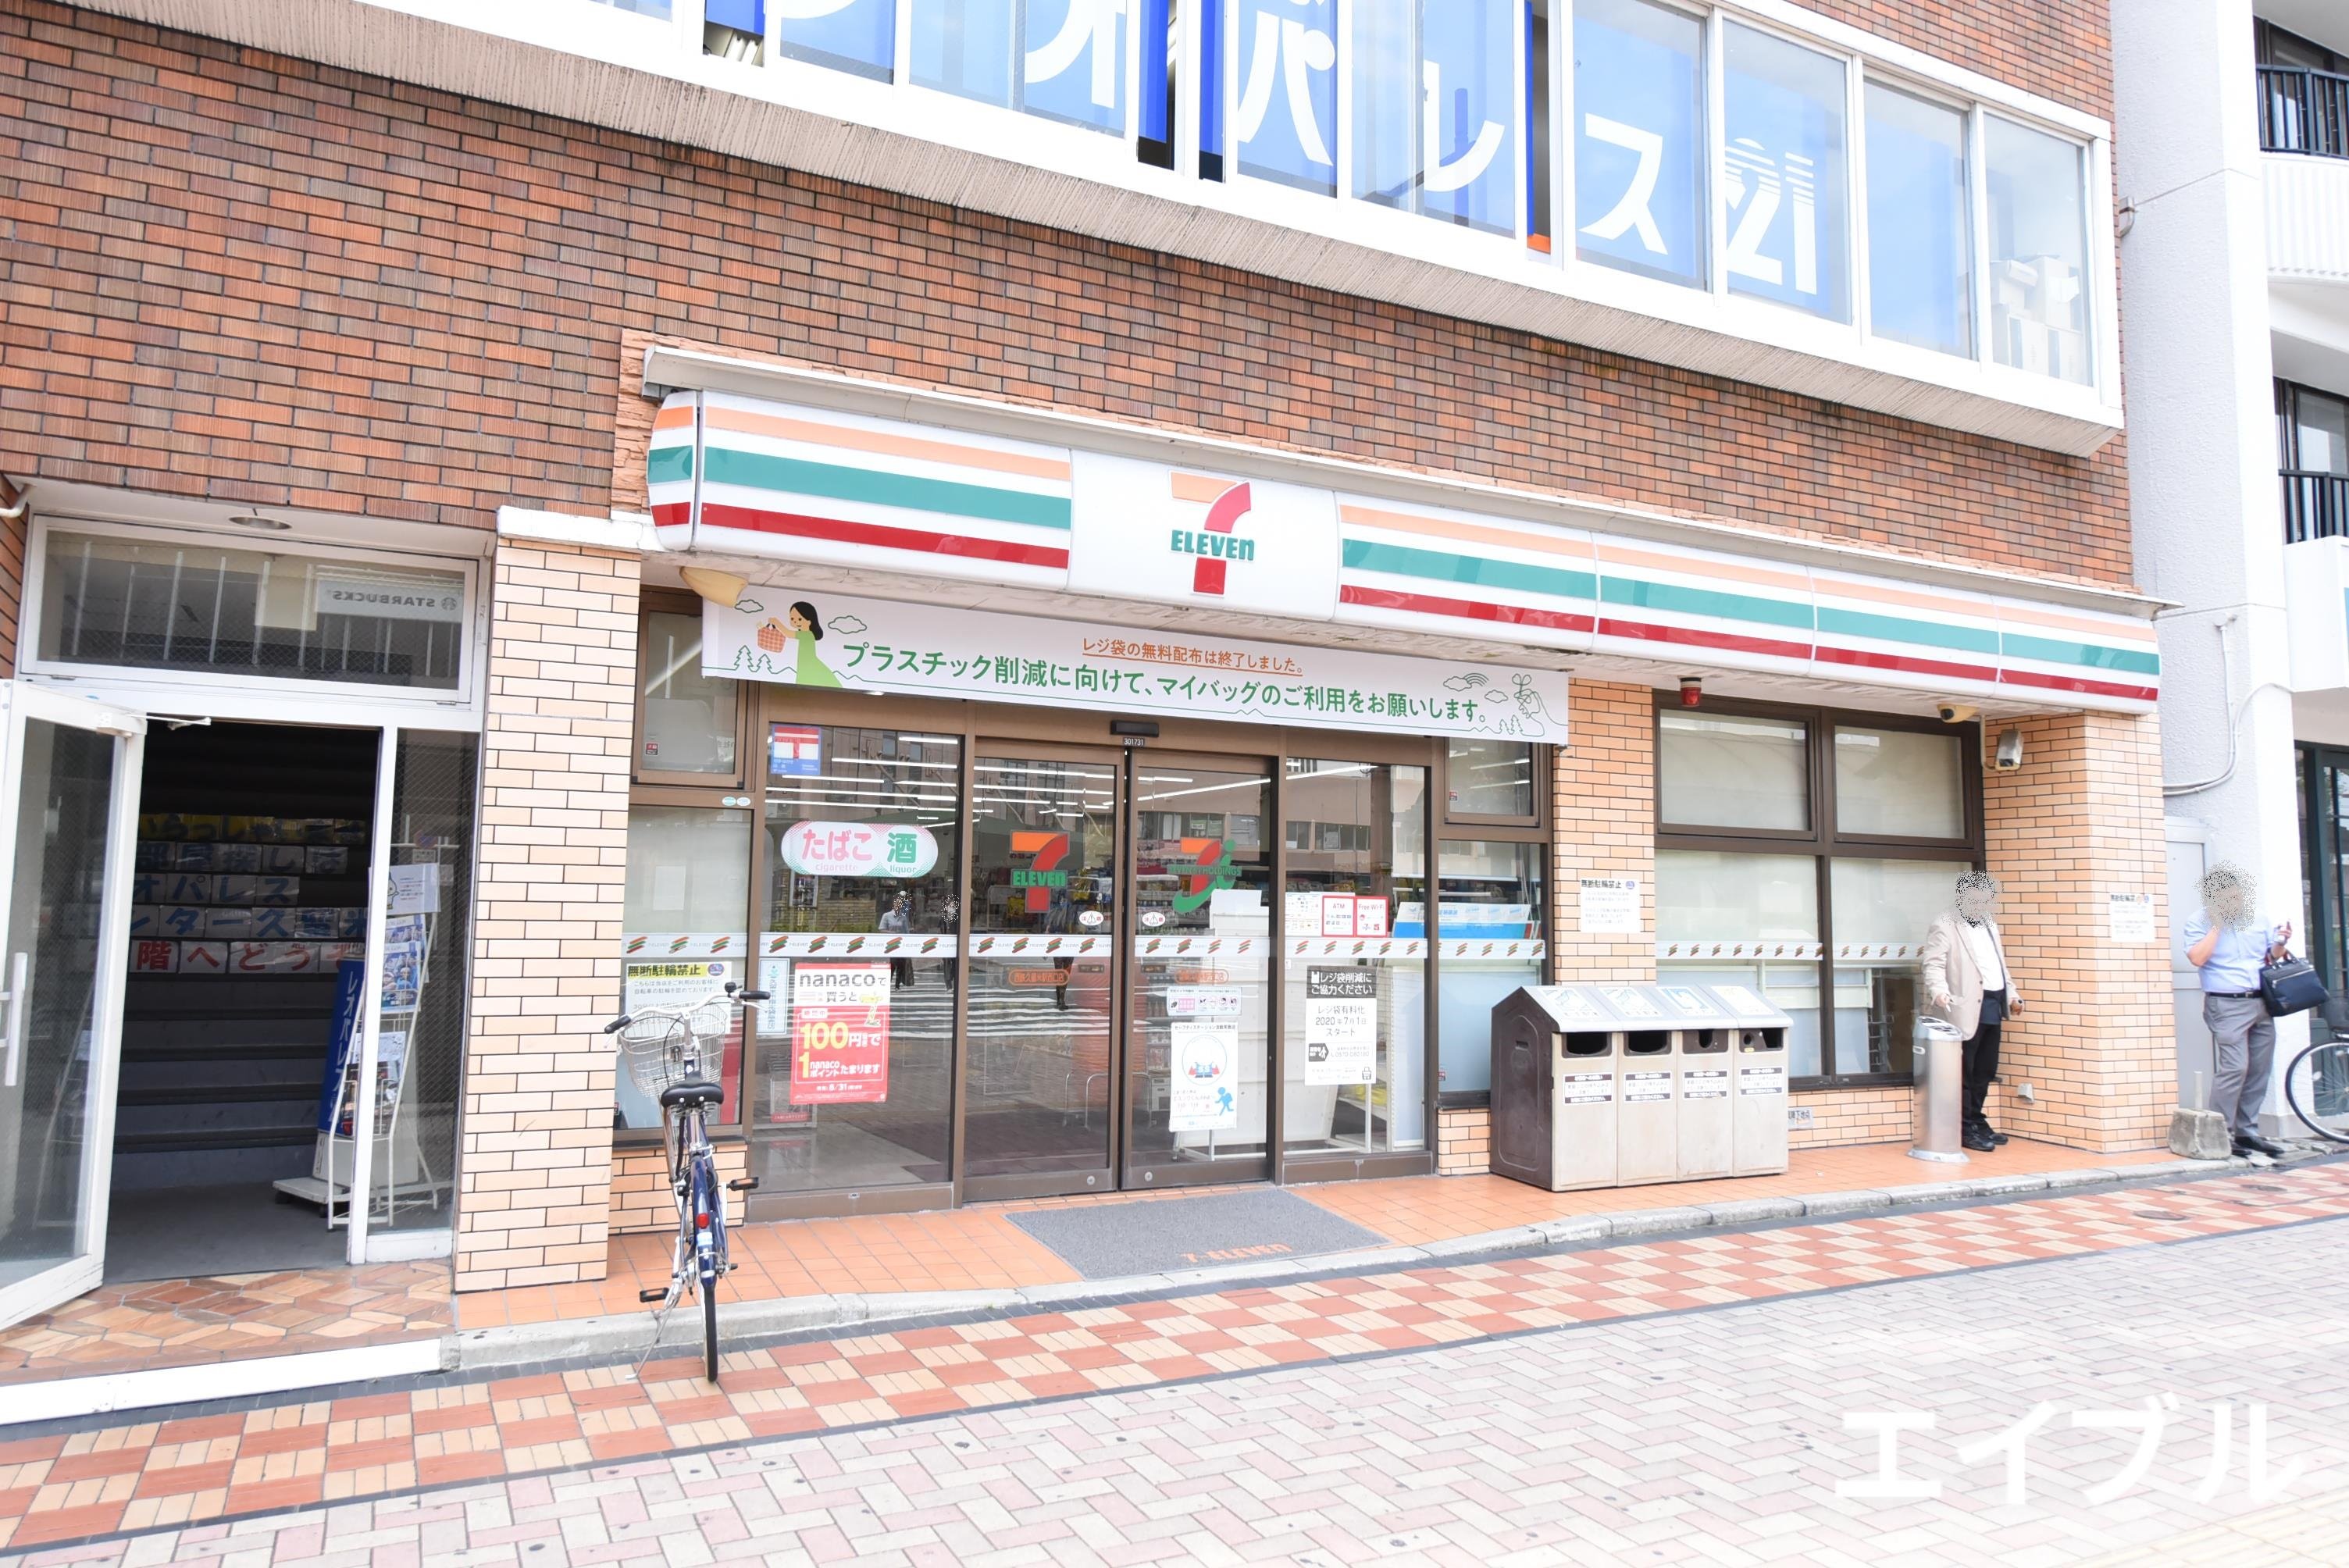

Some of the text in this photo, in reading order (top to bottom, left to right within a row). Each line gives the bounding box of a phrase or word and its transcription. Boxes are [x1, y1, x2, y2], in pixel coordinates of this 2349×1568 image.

[1082, 637, 1303, 675] レジ袋の無料配布は終了しました。
[843, 643, 1486, 723] プラスチック削減に向けて、マイバッグのご利用をお願いします。
[1124, 738, 1144, 747] 301731
[802, 829, 917, 863] たばこ 酒
[815, 863, 917, 874] cigarette liquor
[628, 964, 701, 977] 無断駐輪禁止
[1320, 972, 1372, 983] レジ袋削減に
[1311, 985, 1373, 995] ご協力ください
[826, 991, 857, 1003] 買うと
[1317, 1005, 1366, 1014] レジ袋有料化
[1315, 1017, 1367, 1025] 2020年7月1日
[1325, 1028, 1356, 1037] スタート
[799, 1051, 810, 1078] 1
[840, 1064, 880, 1074] たまります
